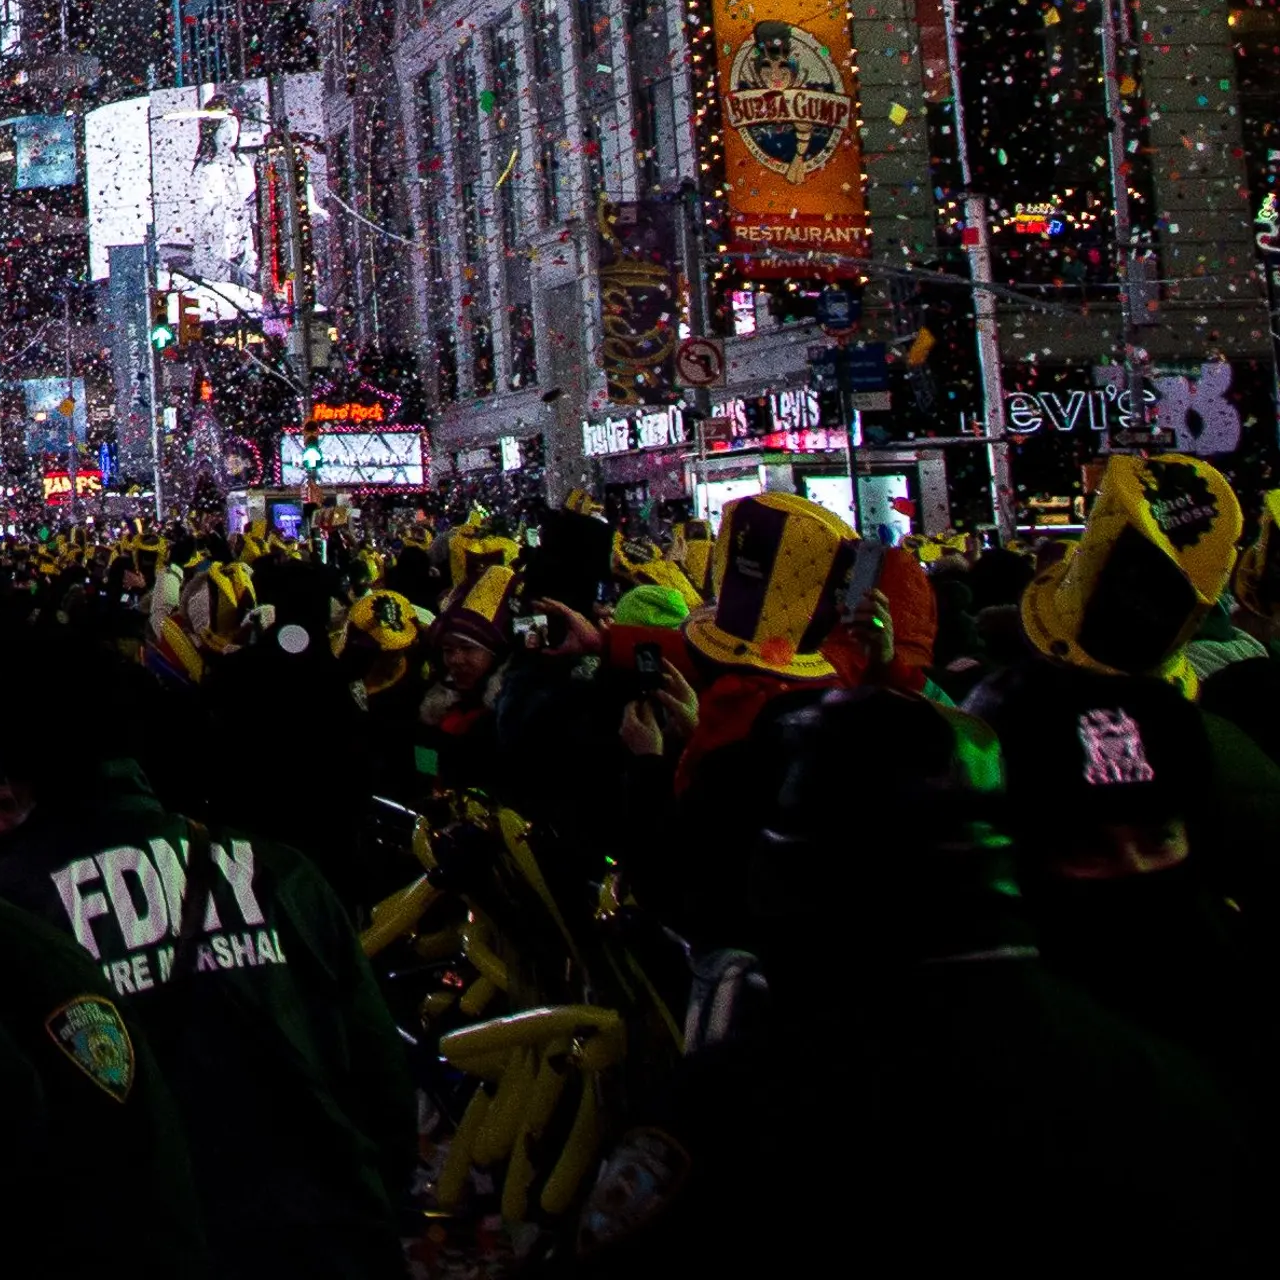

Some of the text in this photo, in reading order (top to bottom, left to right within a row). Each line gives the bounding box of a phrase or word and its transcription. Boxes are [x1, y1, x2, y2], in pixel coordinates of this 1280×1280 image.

[793, 91, 849, 127] GUMP
[734, 225, 862, 243] RESTAURANT
[49, 834, 266, 962] FDNY
[156, 927, 288, 986] MRSHAL
